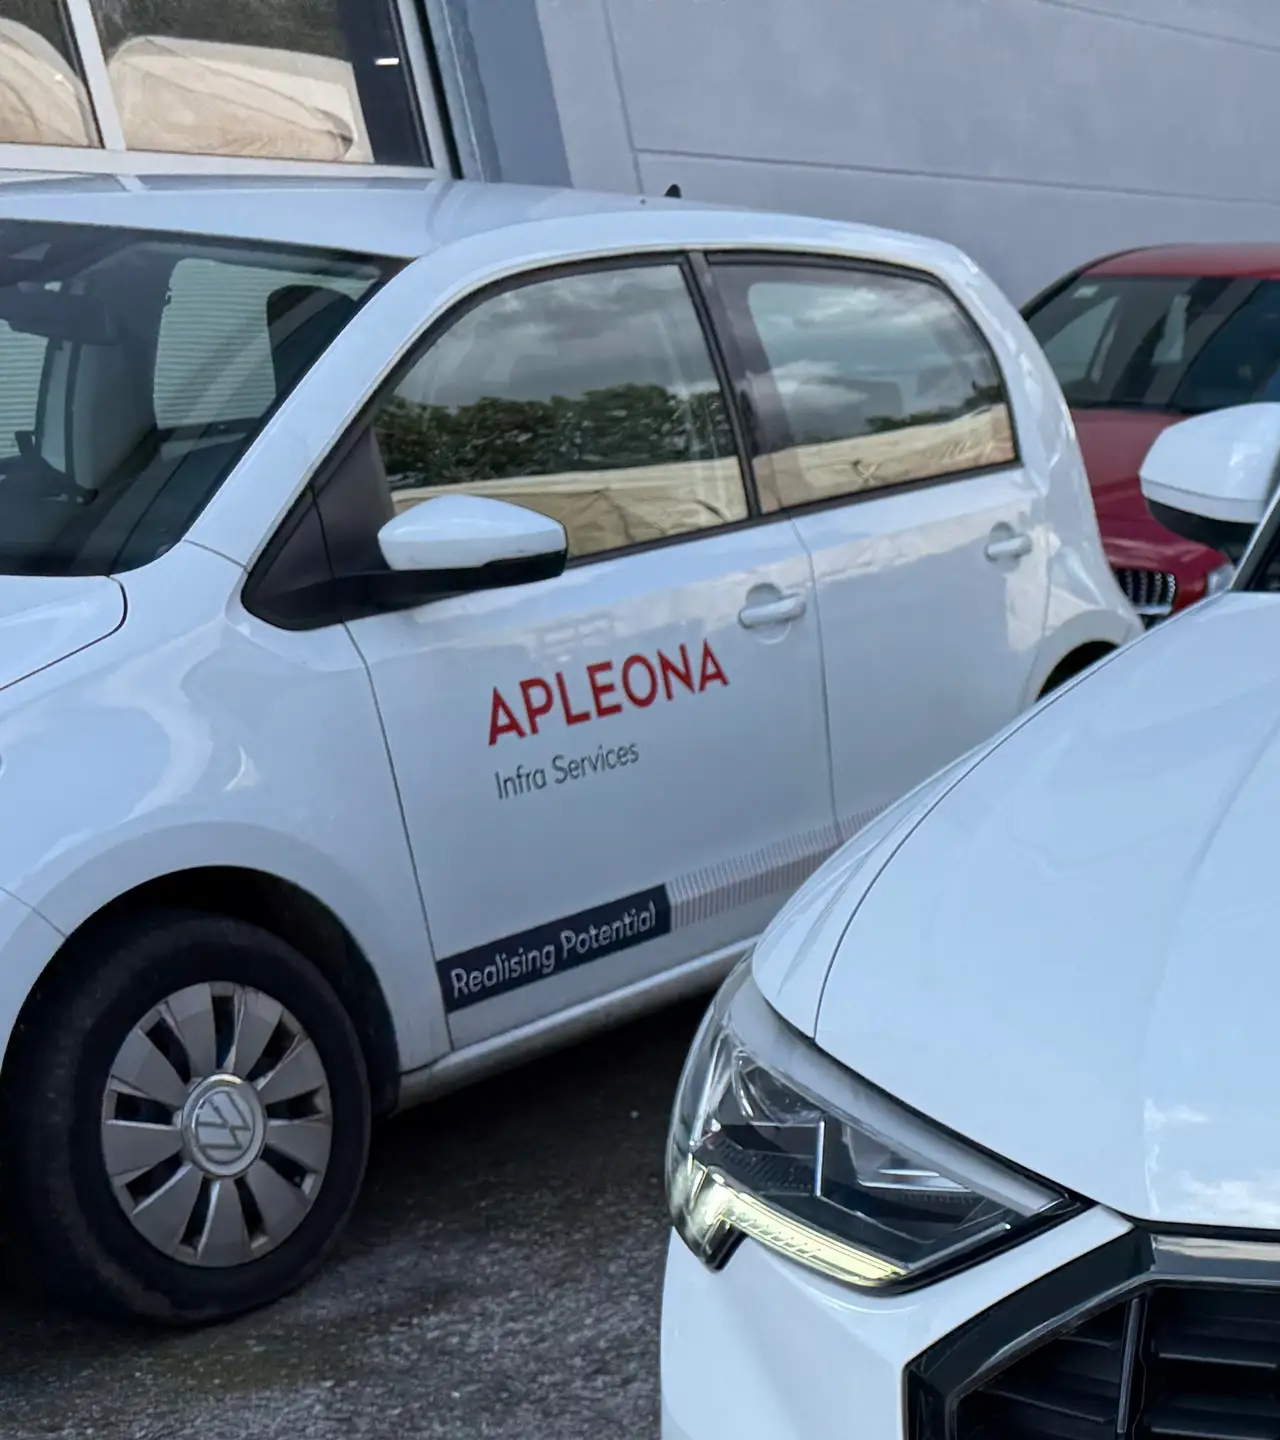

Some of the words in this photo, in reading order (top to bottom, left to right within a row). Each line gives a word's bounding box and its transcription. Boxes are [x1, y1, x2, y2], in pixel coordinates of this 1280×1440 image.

[487, 638, 730, 747] APLEONA
[493, 764, 548, 800] Infra
[552, 742, 641, 785] Services
[450, 944, 556, 999] Realising
[559, 900, 657, 960] Potential
